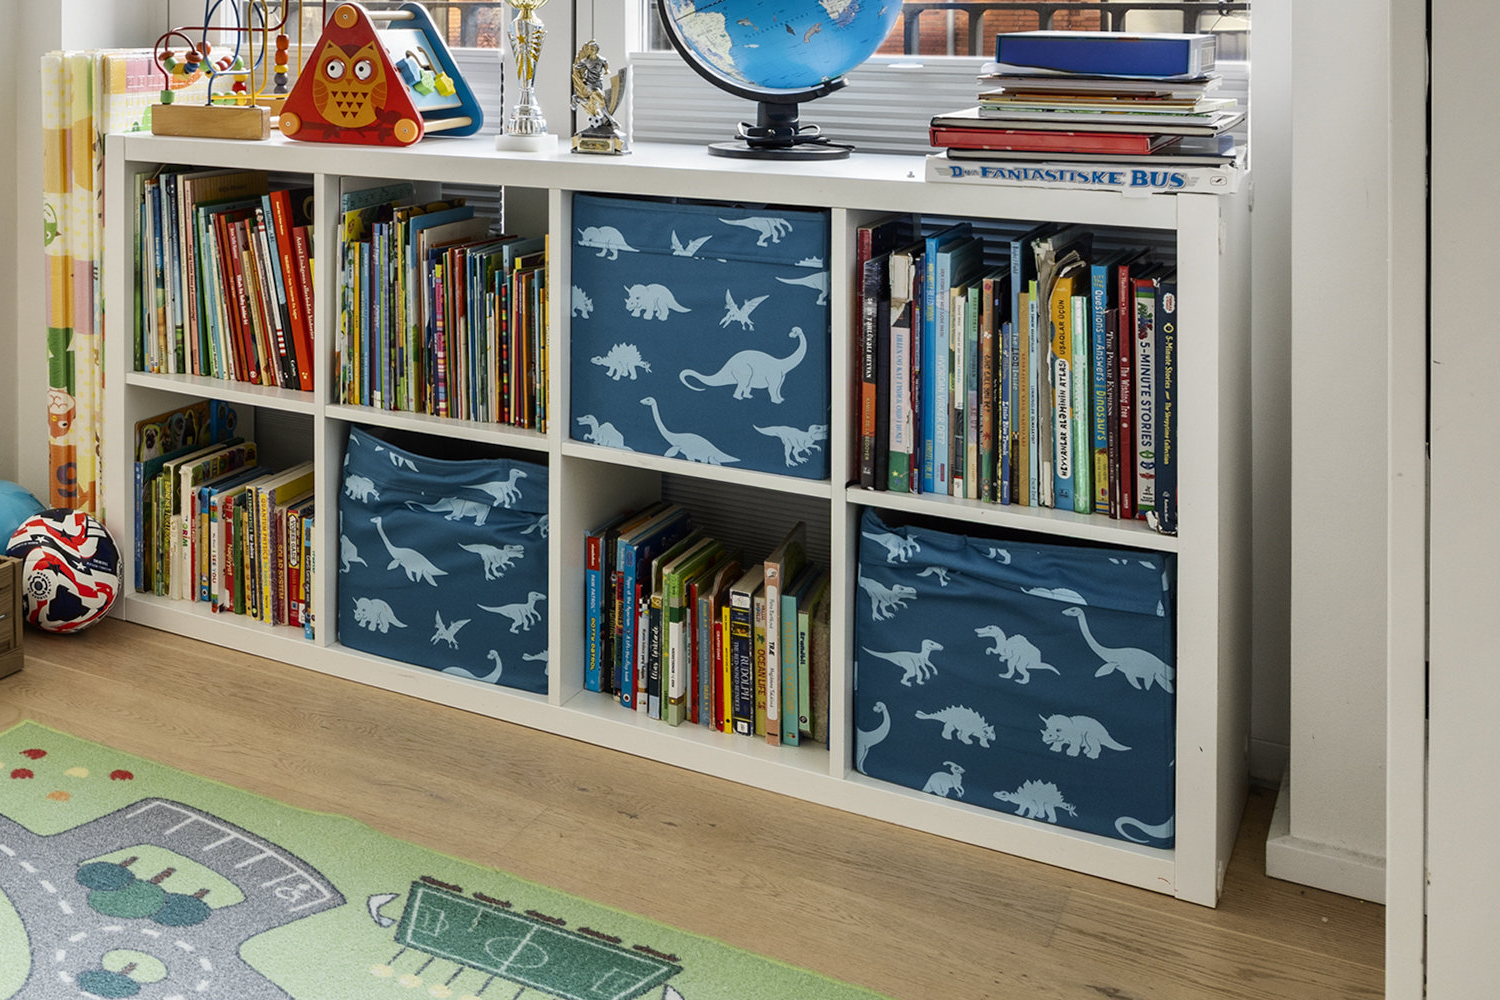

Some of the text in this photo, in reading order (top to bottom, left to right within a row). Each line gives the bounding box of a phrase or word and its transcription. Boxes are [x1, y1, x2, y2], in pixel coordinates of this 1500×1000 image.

[980, 165, 1124, 187] FANTASTISKE
[1130, 168, 1188, 190] BUS
[296, 236, 304, 254] Astrid
[298, 256, 308, 284] Lindgrens
[1094, 290, 1104, 333] Questions
[1058, 360, 1066, 387] ATLASI
[1095, 344, 1106, 381] Answers
[1106, 352, 1114, 378] POLAR
[1140, 341, 1152, 397] 5-MINUTE
[1164, 335, 1174, 388] 5-Minute Stories
[936, 355, 946, 444] HVORDAN VIRKER DET?
[1120, 367, 1130, 418] The Wishing Tree
[1096, 391, 1106, 440] Dinosaurs
[1141, 400, 1152, 447] STORIES
[1060, 432, 1068, 476] HEYVANLAR
[1164, 439, 1172, 464] Collection
[260, 498, 268, 531] QUANTUM
[740, 656, 750, 700] RUDOLPH
[757, 649, 766, 695] OCEAN LIFE
